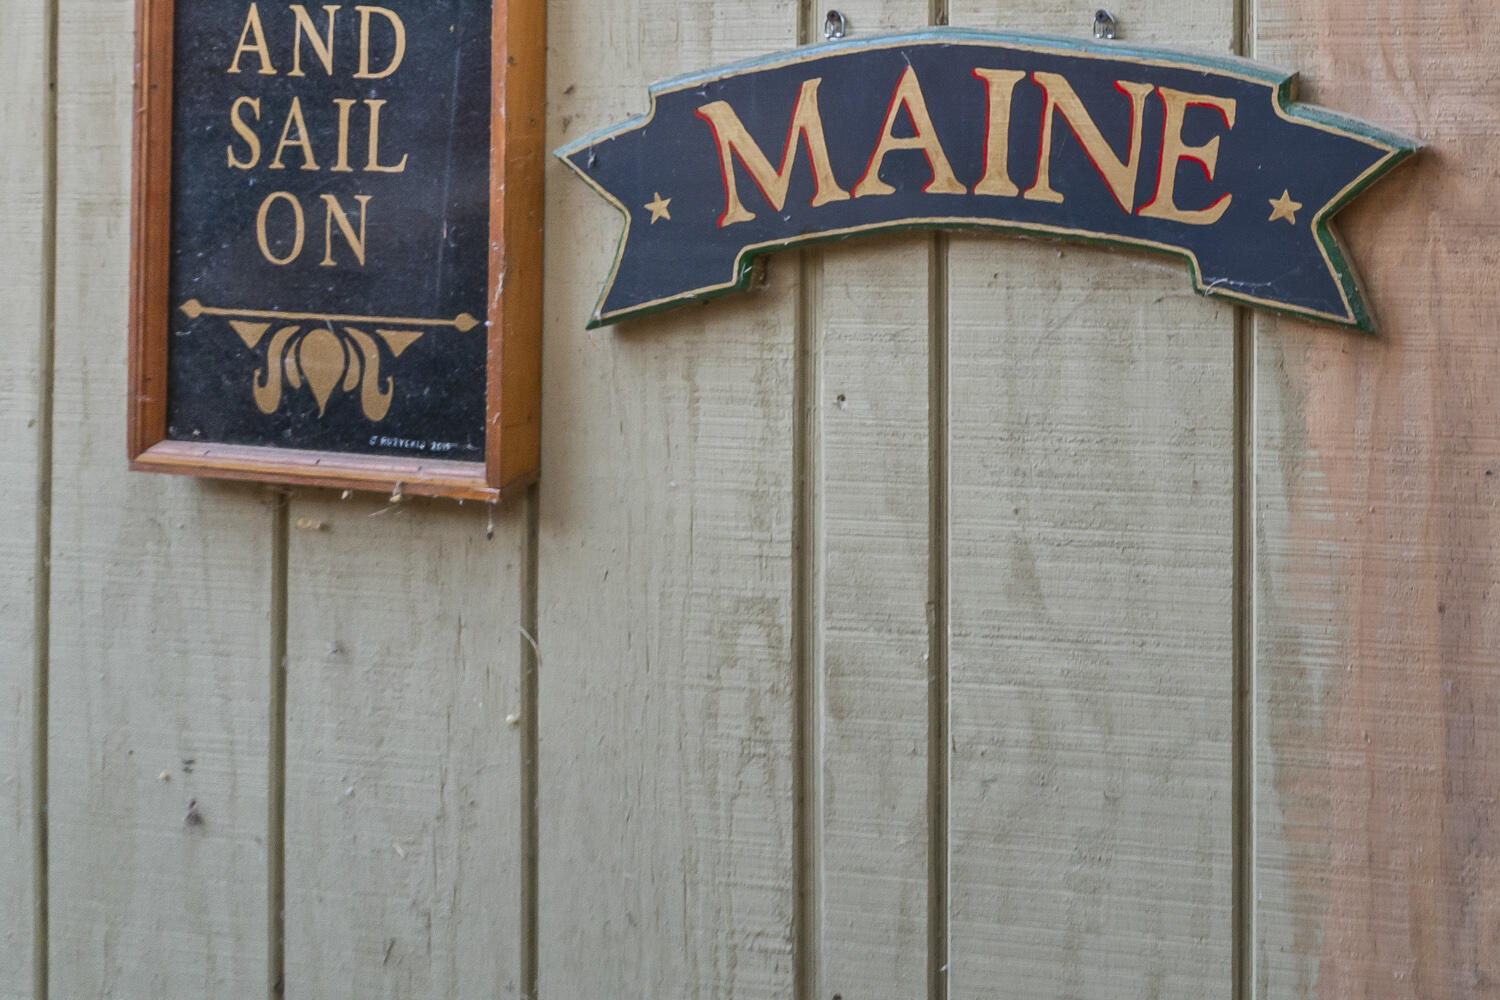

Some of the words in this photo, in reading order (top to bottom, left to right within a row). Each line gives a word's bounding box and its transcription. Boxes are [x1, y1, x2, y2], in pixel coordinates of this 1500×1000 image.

[227, 3, 406, 79] AND
[227, 96, 408, 173] SAIL
[694, 66, 1236, 228] MAINE
[256, 191, 373, 266] ON
